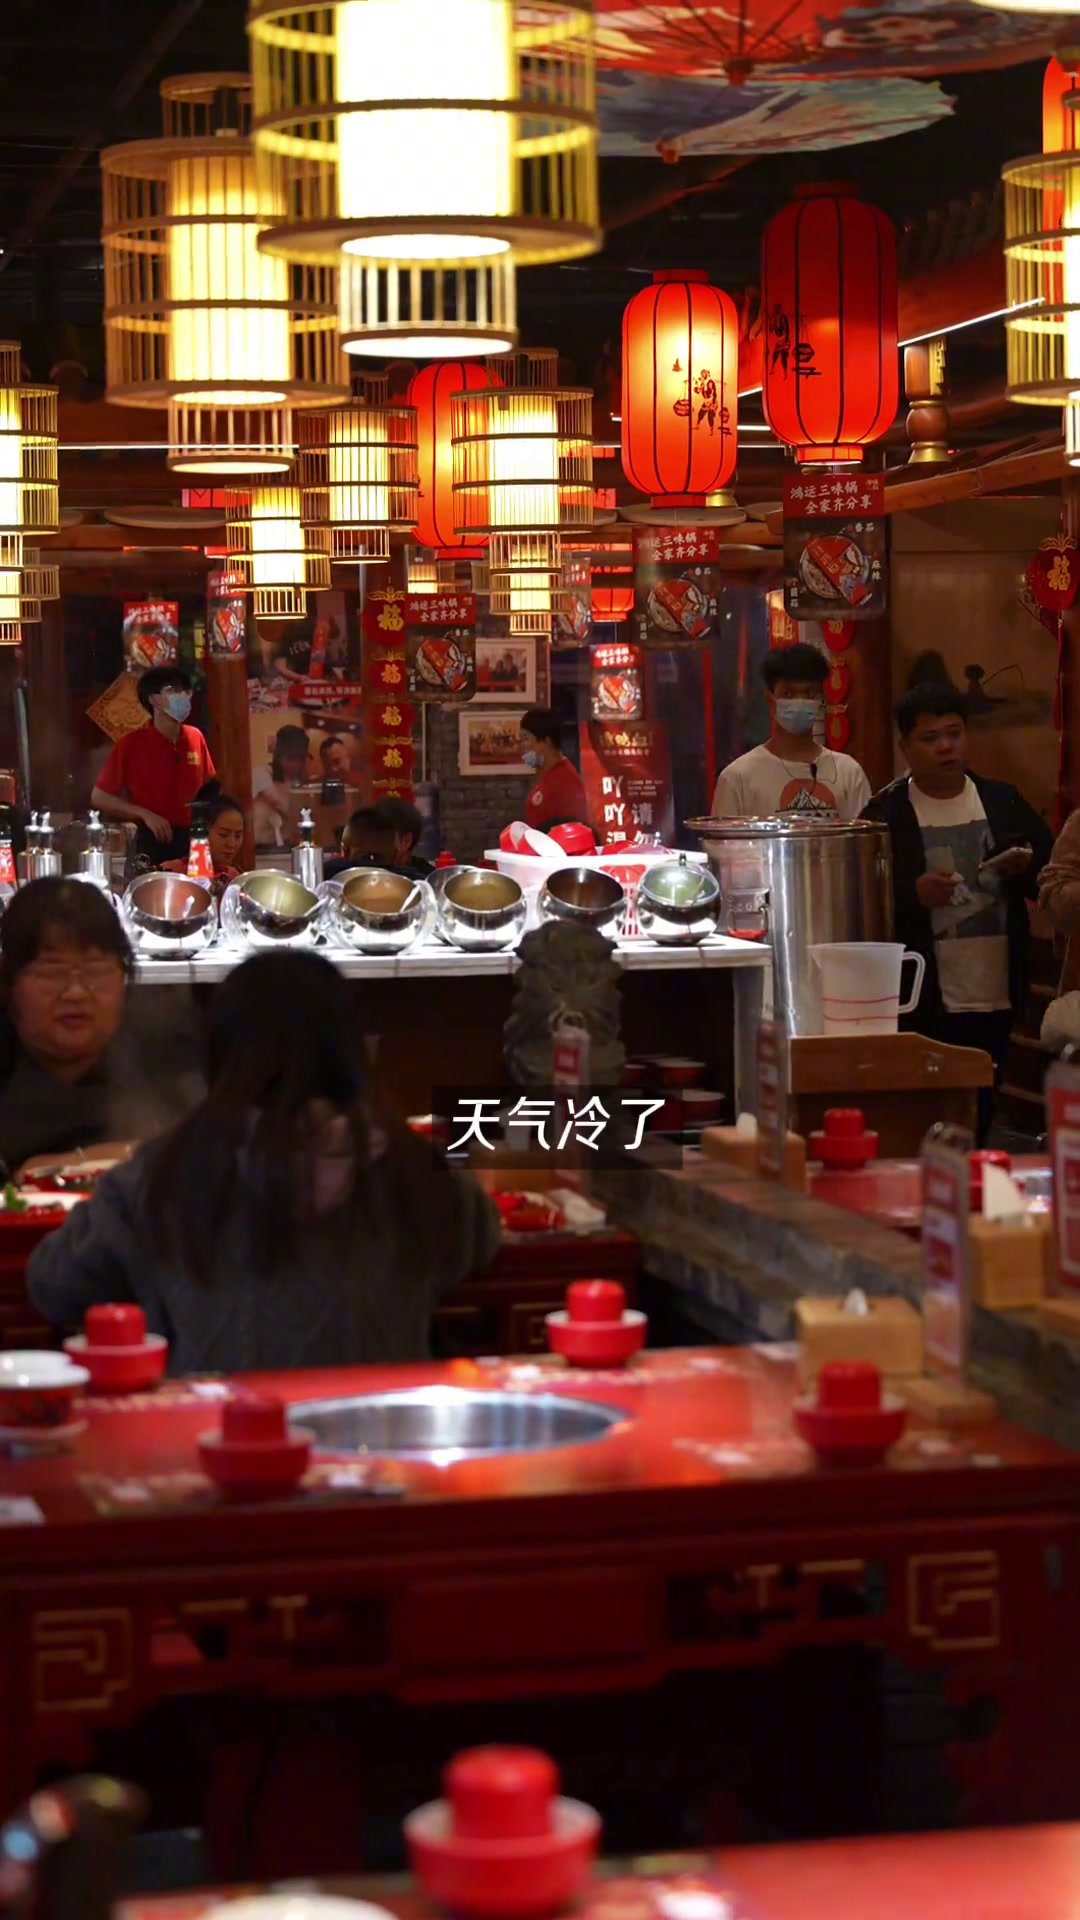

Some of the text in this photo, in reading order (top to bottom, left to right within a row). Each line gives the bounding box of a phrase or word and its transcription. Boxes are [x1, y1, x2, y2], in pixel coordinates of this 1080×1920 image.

[790, 481, 859, 501] 鸿运三味锅
[805, 494, 872, 514] 全家齐分享
[639, 532, 697, 549] 运三味锅
[652, 544, 709, 561] 全家齐分享
[1047, 555, 1071, 591] 福
[377, 603, 405, 632] 福
[380, 663, 402, 685] 福
[381, 705, 403, 727] 福
[382, 748, 404, 769] 福
